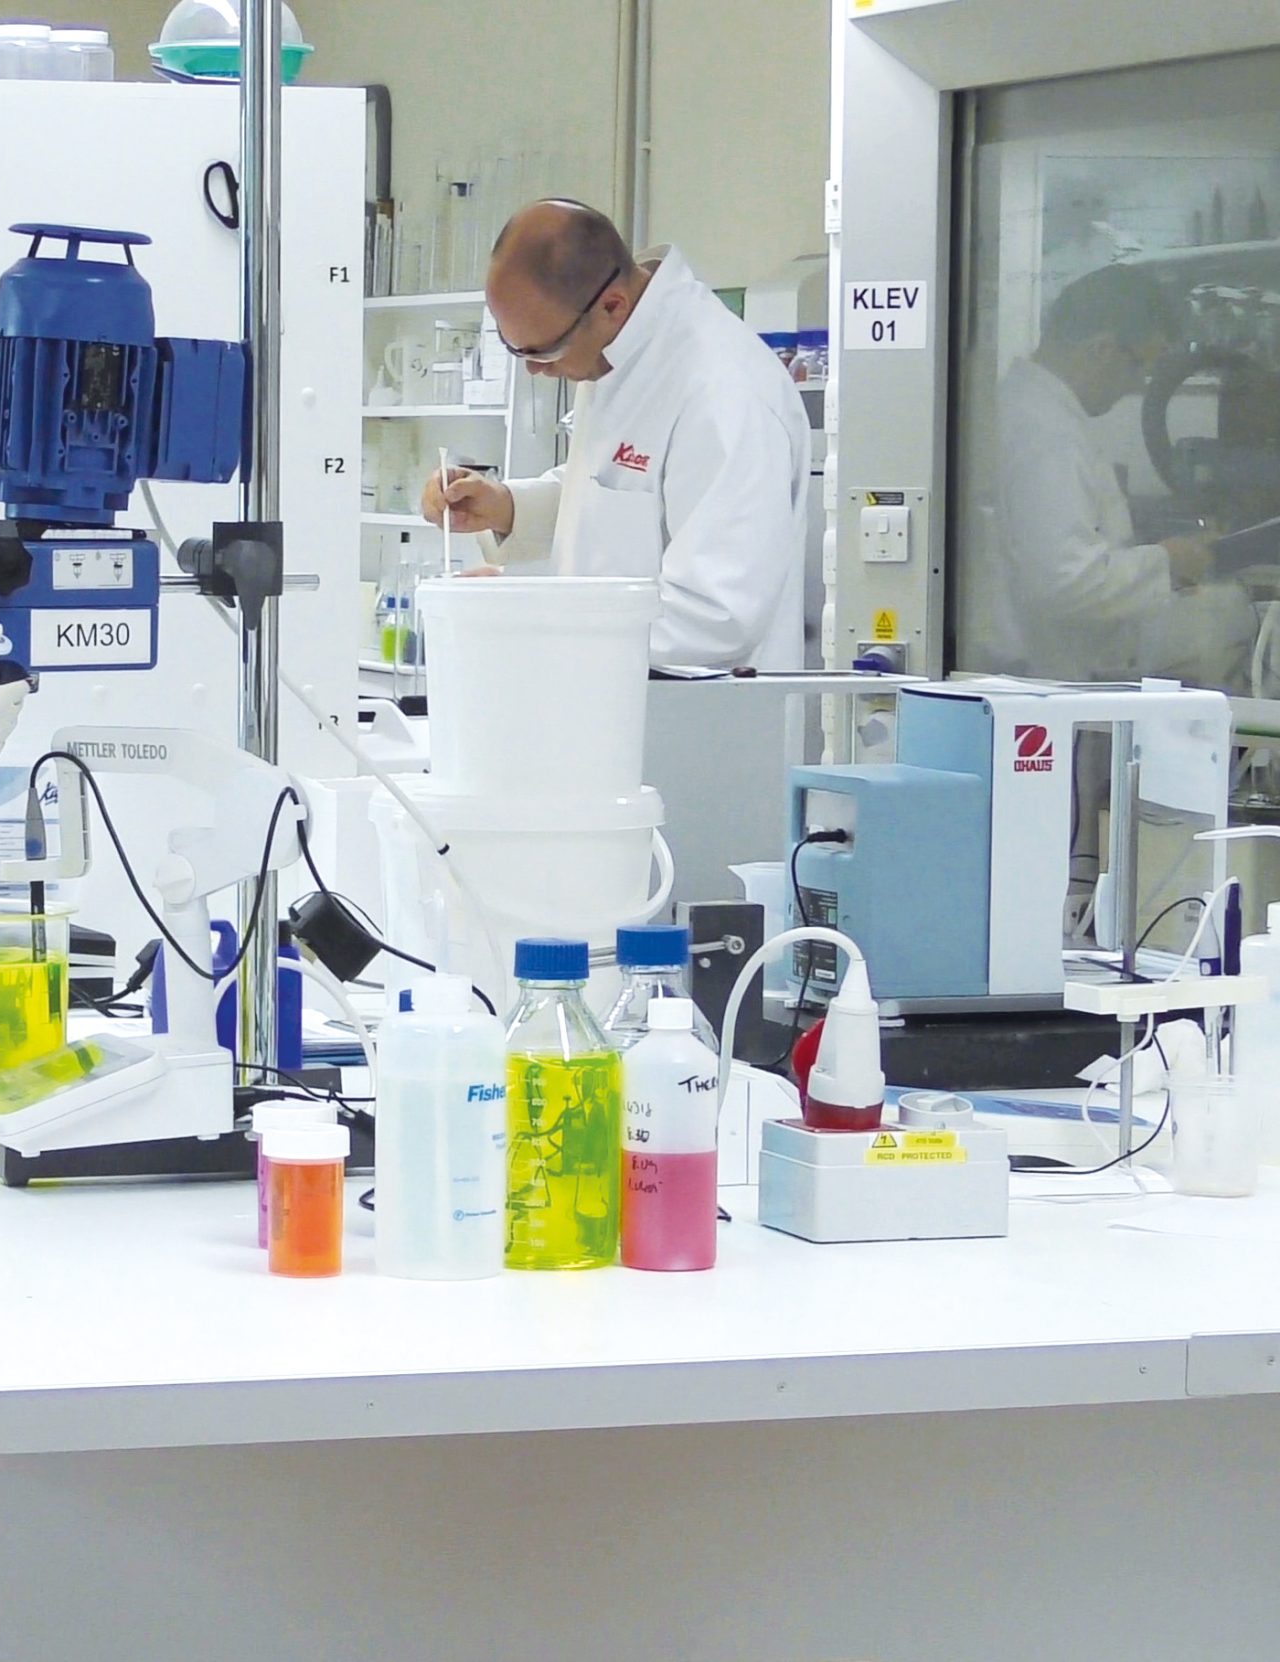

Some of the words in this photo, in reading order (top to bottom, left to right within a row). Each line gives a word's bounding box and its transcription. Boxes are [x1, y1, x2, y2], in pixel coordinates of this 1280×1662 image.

[330, 266, 350, 283] F1
[853, 287, 919, 310] KLEV
[871, 320, 895, 342] 01
[324, 457, 345, 474] F2
[57, 622, 130, 648] KM30
[67, 741, 117, 759] METTLER
[121, 743, 168, 760] TOLEDO
[1014, 760, 1054, 772] OHAUS
[901, 1152, 952, 1160] PROTECTED
